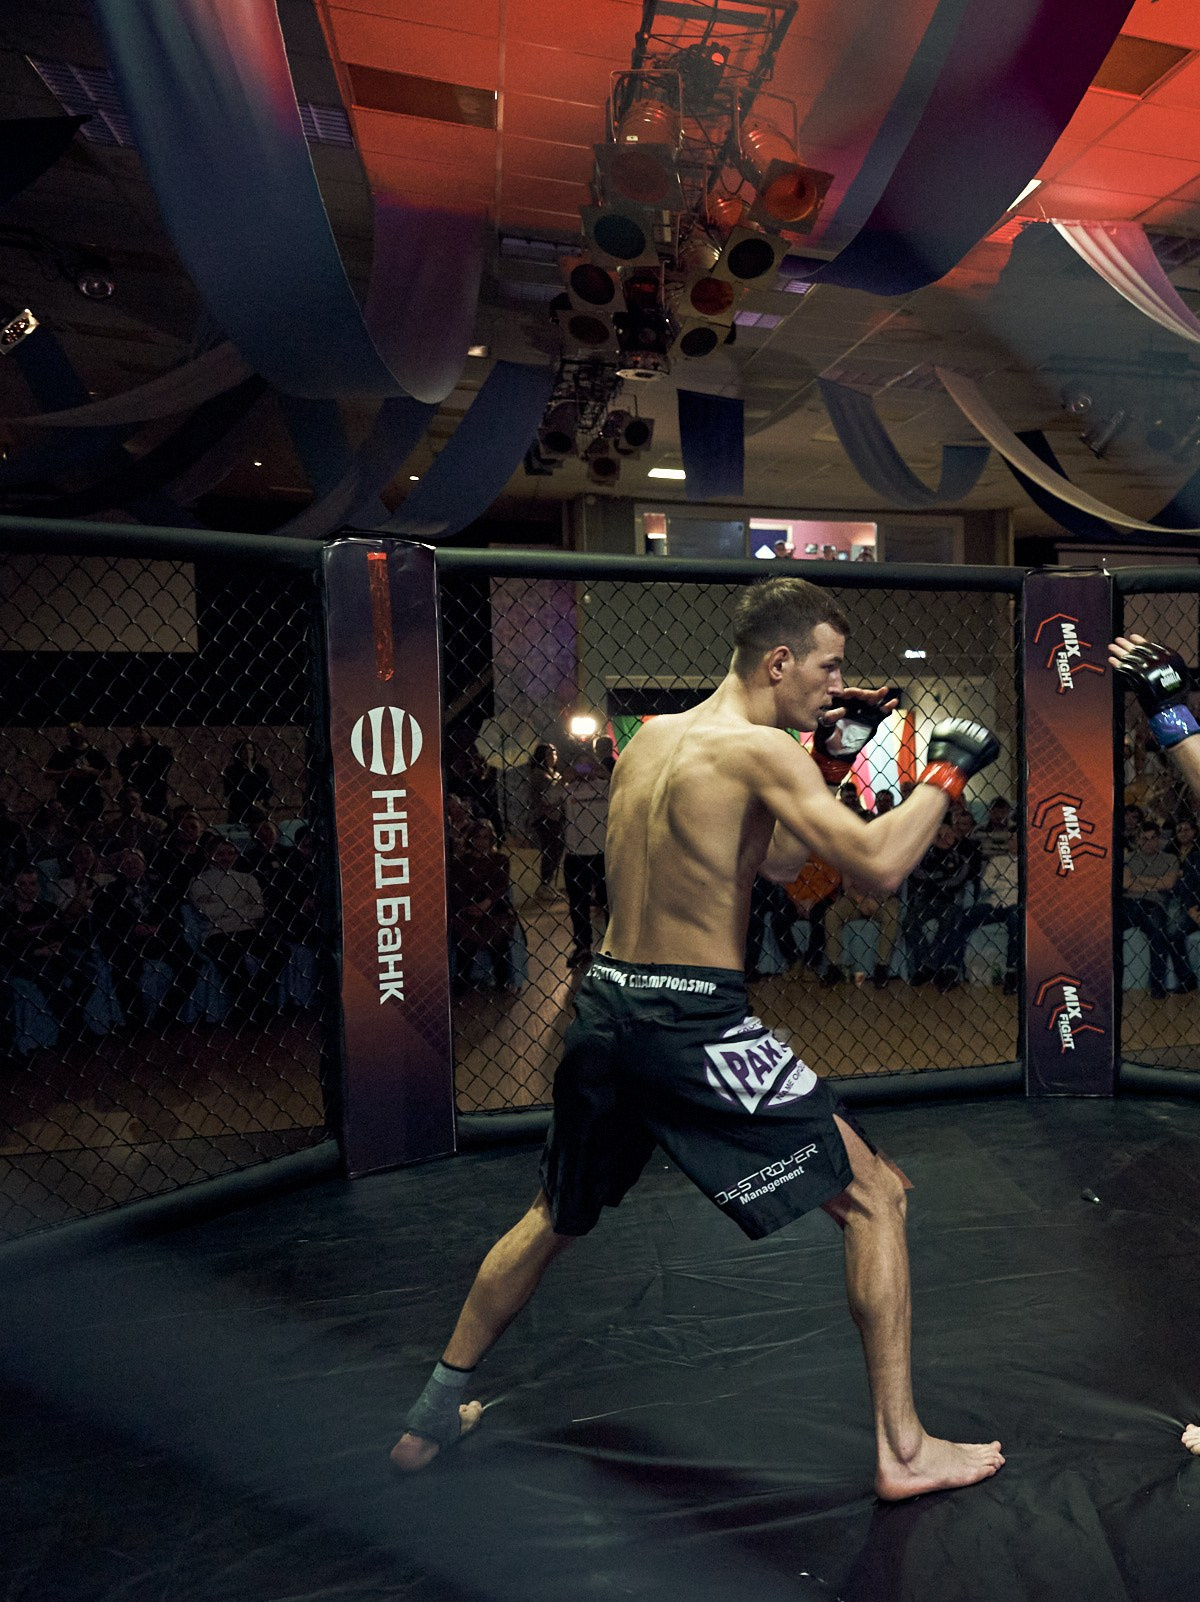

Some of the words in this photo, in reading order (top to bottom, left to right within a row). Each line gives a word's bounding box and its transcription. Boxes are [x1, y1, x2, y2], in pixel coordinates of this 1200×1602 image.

[1061, 623, 1081, 658] MIX
[1057, 652, 1074, 689] FIGHT
[371, 789, 410, 889] НБД
[1062, 806, 1082, 840] MIX
[1058, 834, 1075, 871] FIGHT
[376, 895, 412, 1005] Банк
[629, 974, 717, 996] CHAMPIONSHIP
[1063, 986, 1083, 1020] MIX
[1058, 1013, 1075, 1050] FIGHT
[775, 1078, 795, 1101] NAME
[739, 1165, 805, 1205] Management
